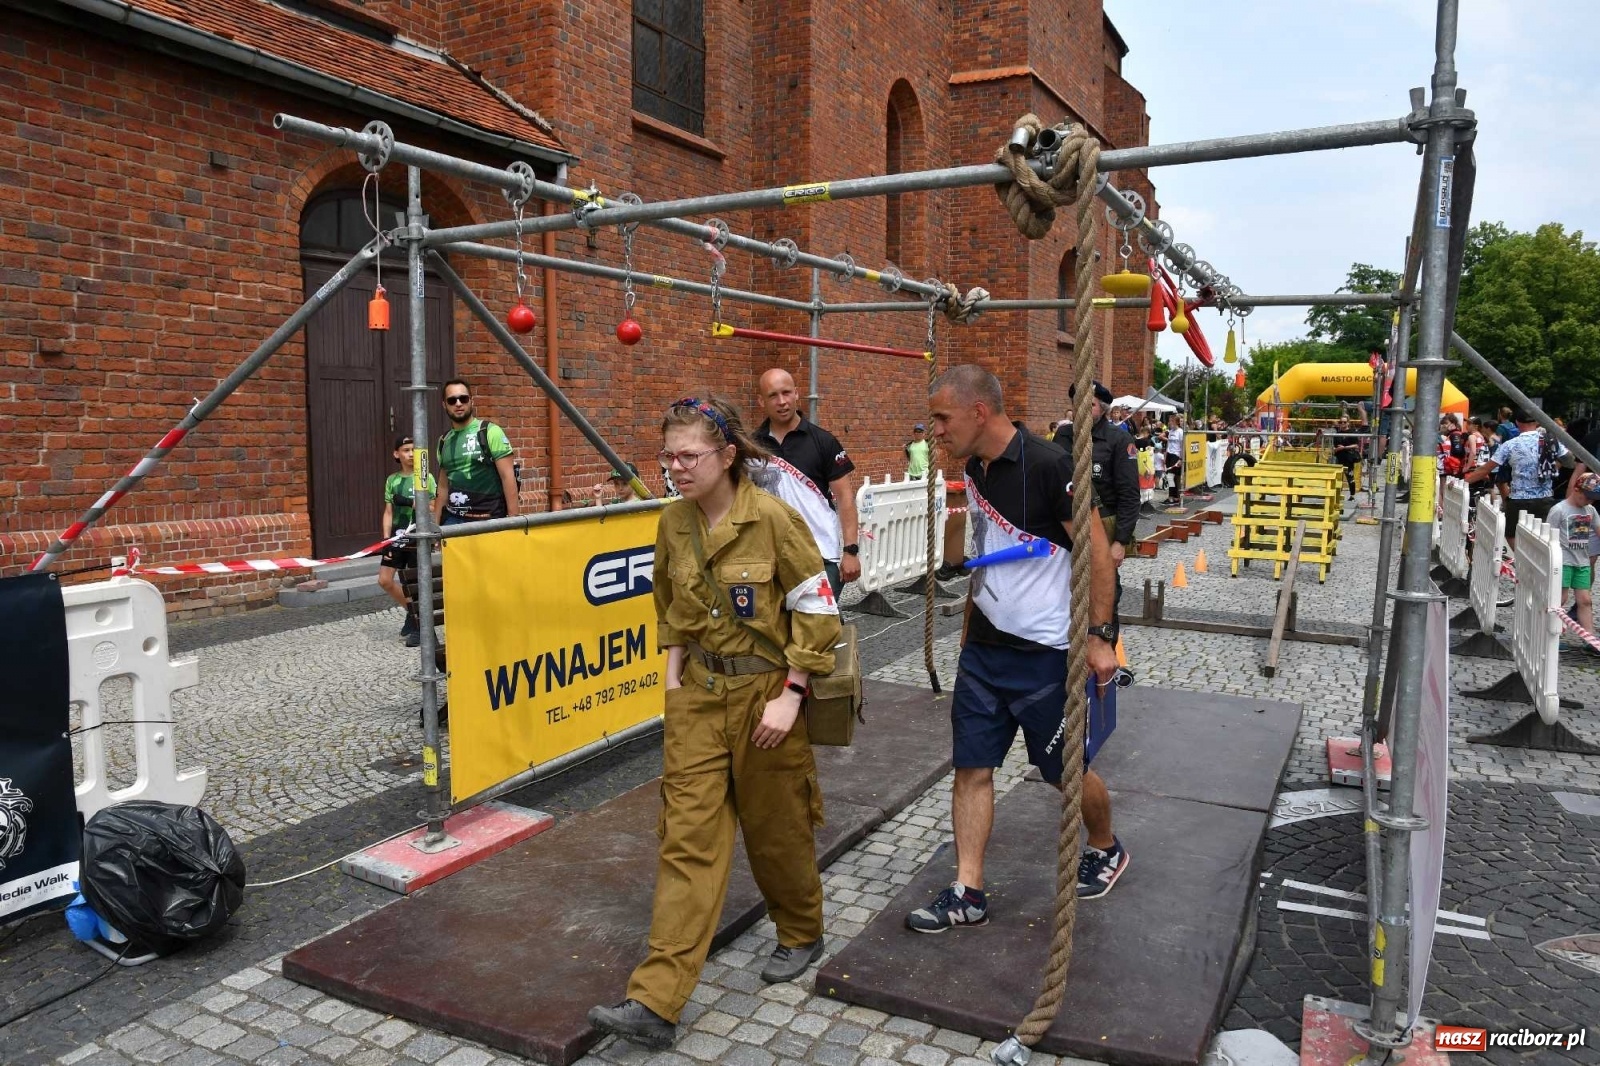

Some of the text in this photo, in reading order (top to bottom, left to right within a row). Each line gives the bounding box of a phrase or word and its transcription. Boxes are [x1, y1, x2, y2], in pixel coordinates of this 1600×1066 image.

[588, 552, 655, 598] ER
[485, 624, 646, 711] WYNAJEM
[546, 672, 658, 725] TEL. +48 792 782 402
[0, 885, 31, 902] edia
[34, 873, 69, 889] Walk
